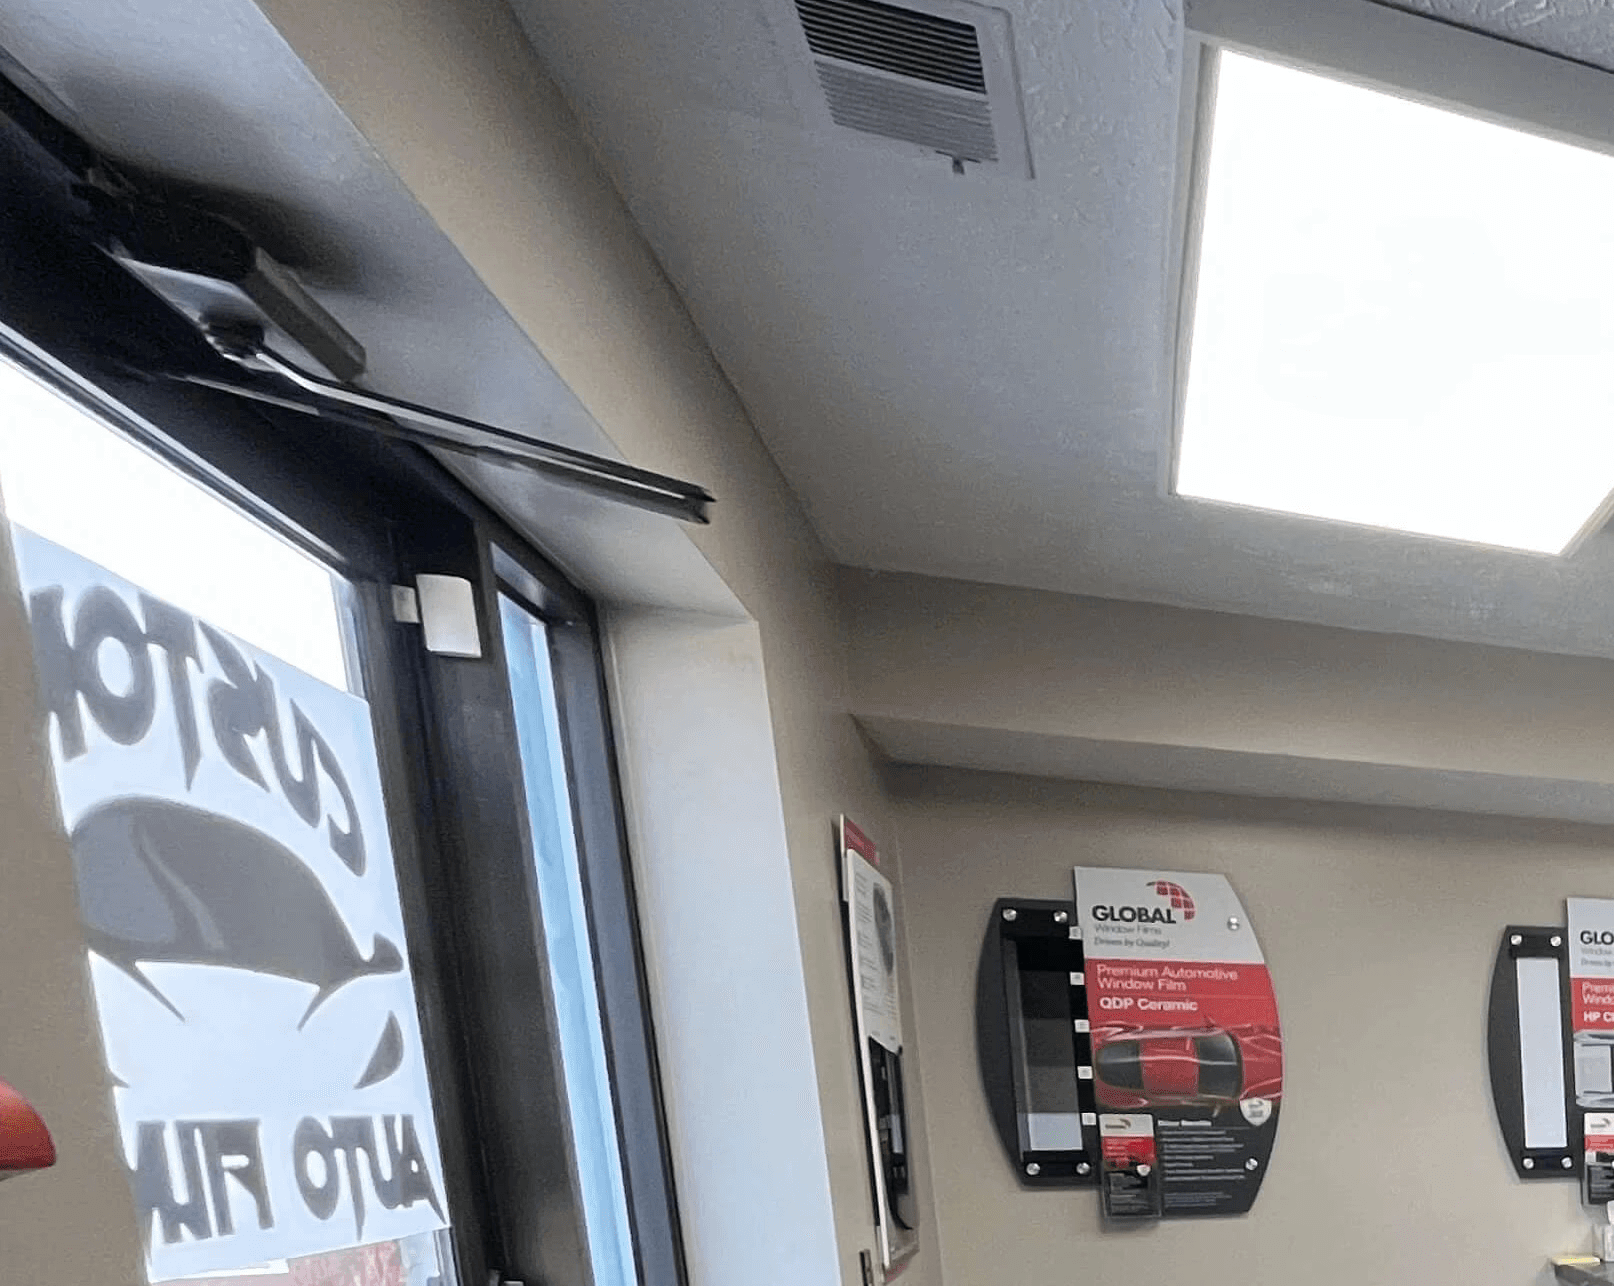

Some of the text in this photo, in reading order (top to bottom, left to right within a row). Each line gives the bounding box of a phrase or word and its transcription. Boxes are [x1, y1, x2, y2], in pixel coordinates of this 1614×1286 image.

[1092, 905, 1176, 924] GLOBAL
[1096, 964, 1239, 980] Premium Automotive
[1098, 977, 1187, 991] Window Film
[1100, 997, 1198, 1011] QDP Ceramic
[1584, 1011, 1601, 1022] HP
